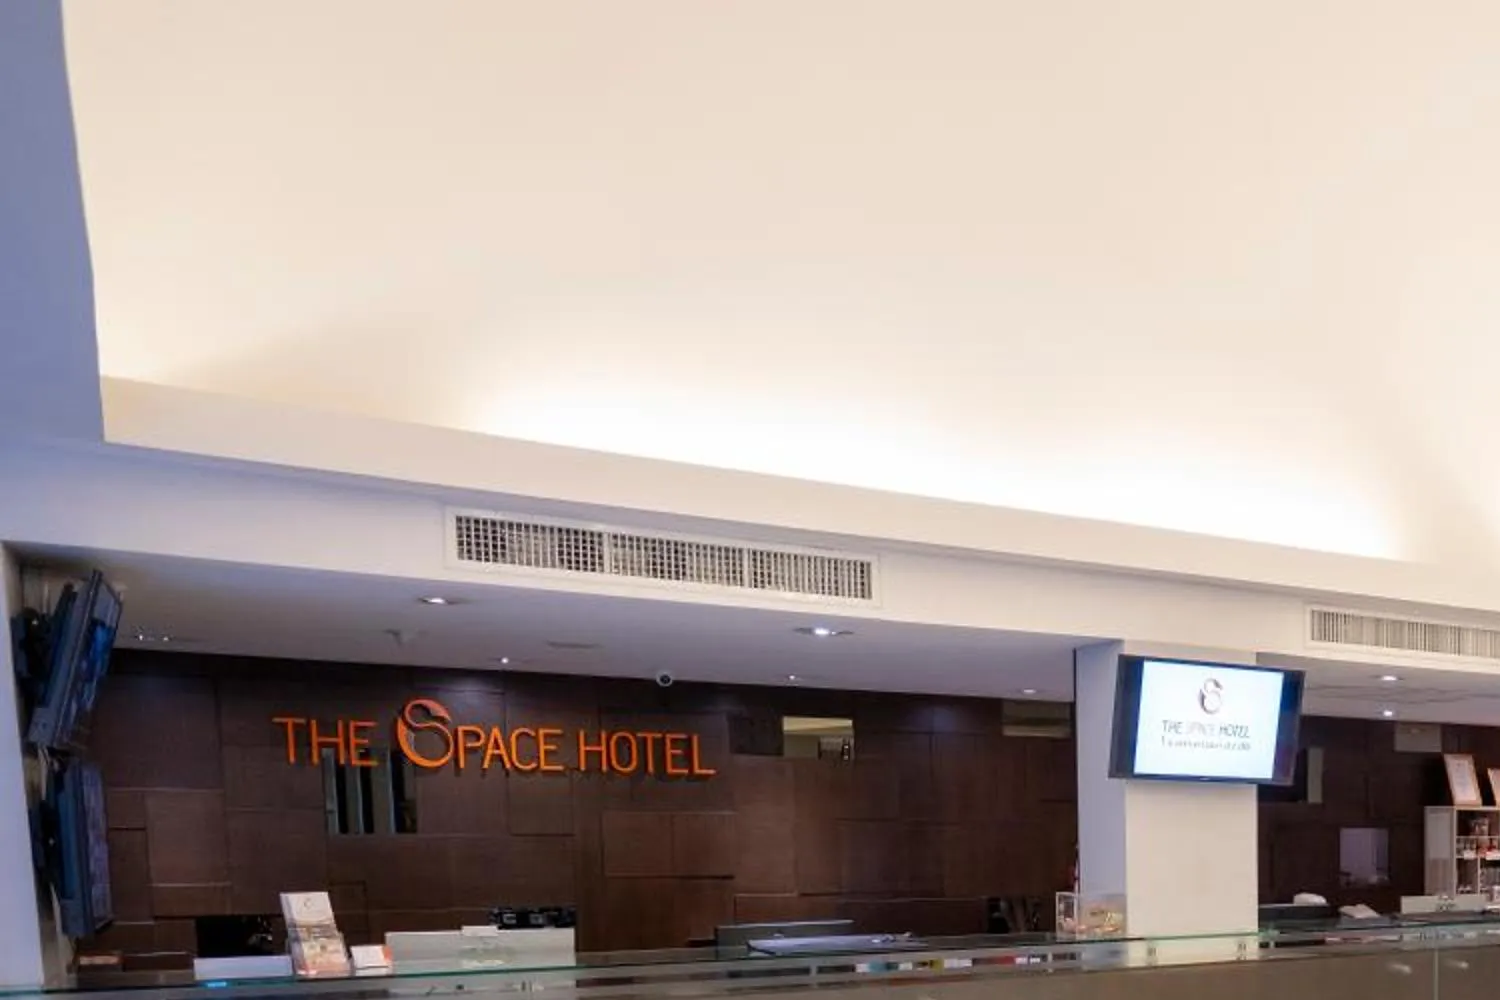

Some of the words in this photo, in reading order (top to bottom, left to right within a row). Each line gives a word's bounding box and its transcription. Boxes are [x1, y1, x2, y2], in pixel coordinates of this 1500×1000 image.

[272, 717, 378, 767] THE
[397, 698, 565, 772] SPACE
[578, 729, 716, 776] HOTEL
[1162, 719, 1183, 735] THE
